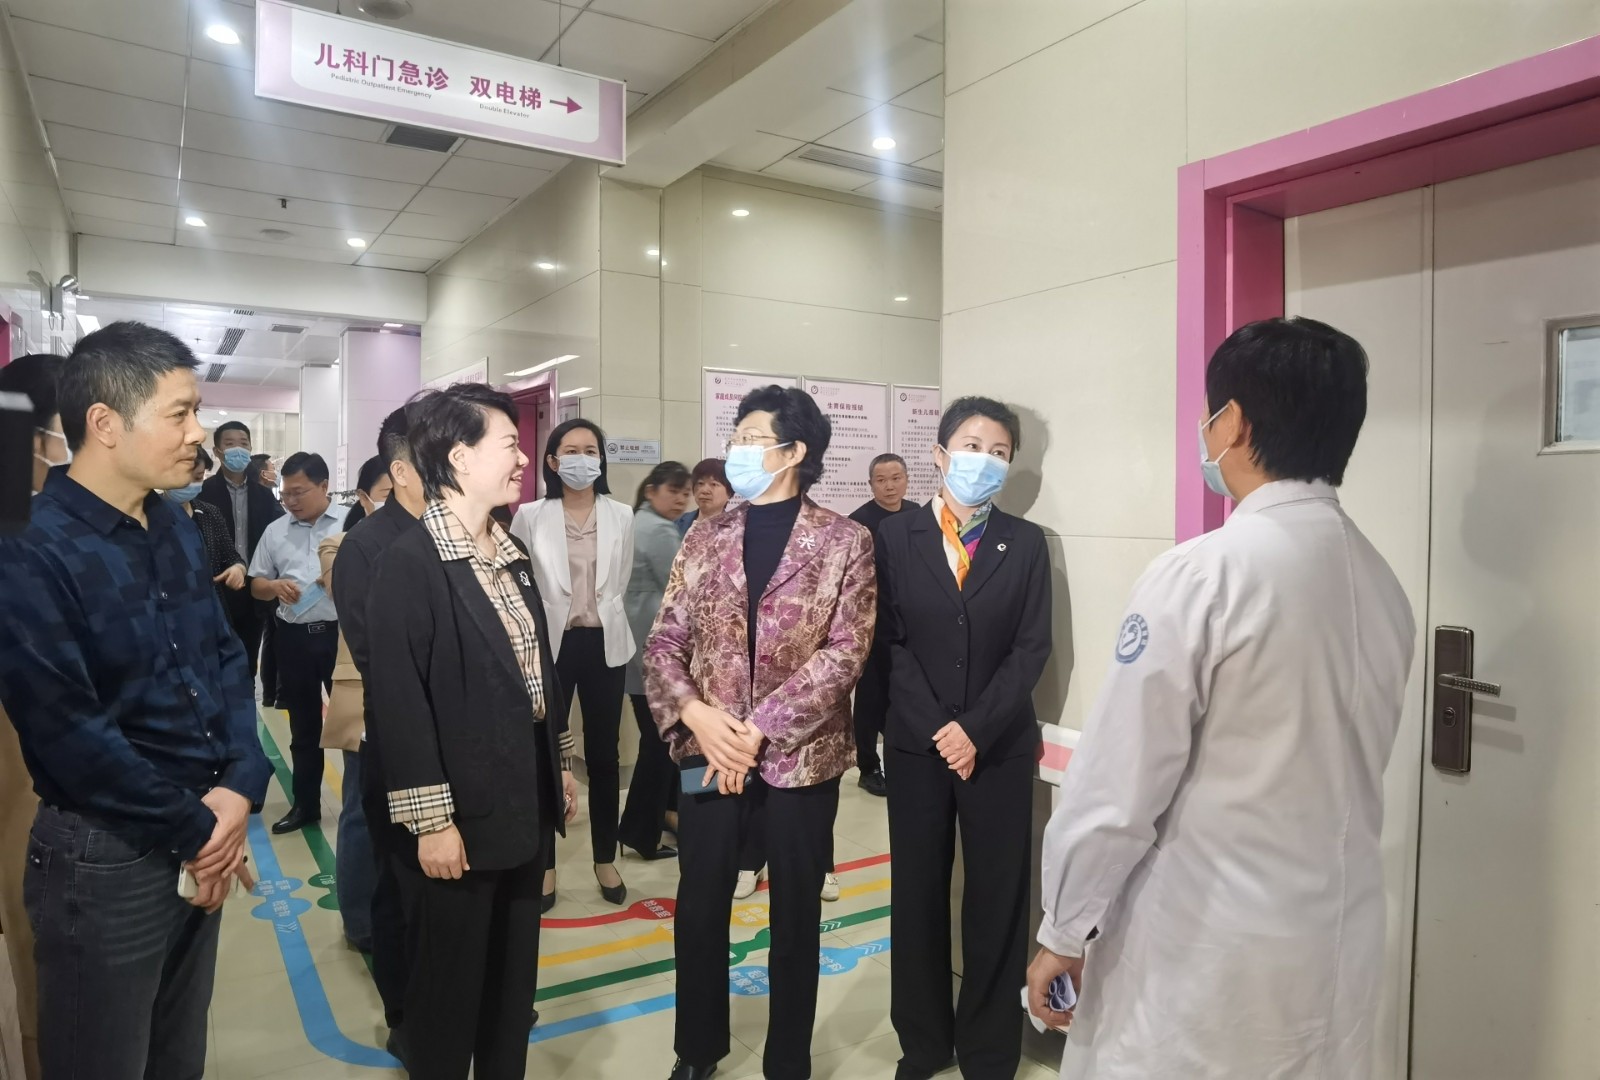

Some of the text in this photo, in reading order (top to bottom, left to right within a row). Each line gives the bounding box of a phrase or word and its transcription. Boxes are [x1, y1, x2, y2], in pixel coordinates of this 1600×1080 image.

[314, 42, 541, 111] 儿科门急诊 双电梯
[361, 78, 396, 92] Outpatient
[397, 86, 432, 99] Emergency
[479, 103, 530, 118] Double Elevator
